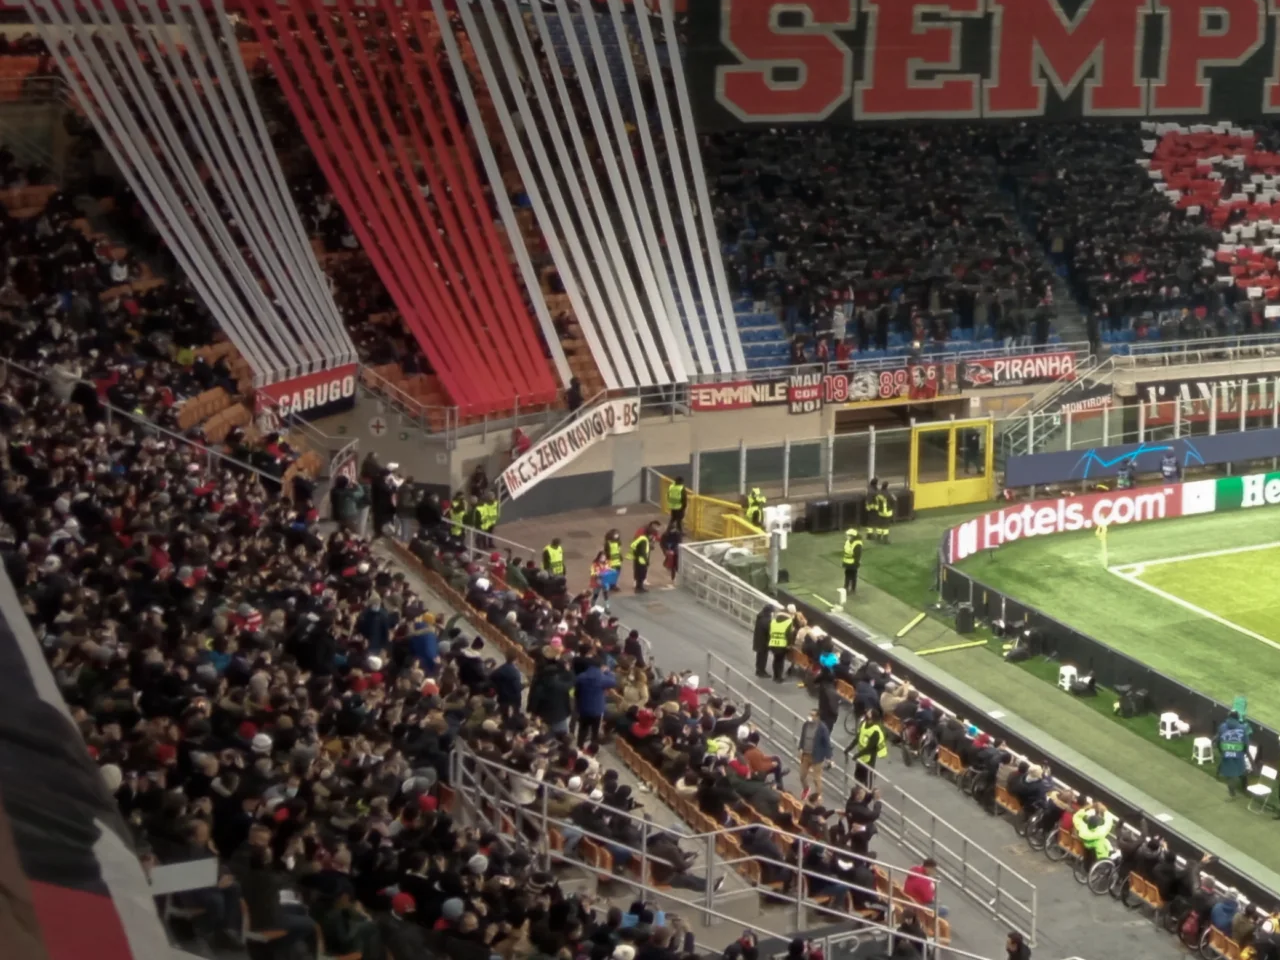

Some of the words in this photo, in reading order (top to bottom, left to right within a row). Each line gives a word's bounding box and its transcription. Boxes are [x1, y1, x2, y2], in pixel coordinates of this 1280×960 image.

[790, 373, 821, 388] MAU
[994, 355, 1074, 381] PIRANHA
[279, 375, 355, 418] CARUGO
[691, 380, 788, 407] FEMMINILE
[984, 492, 1166, 548] Hotels.com
